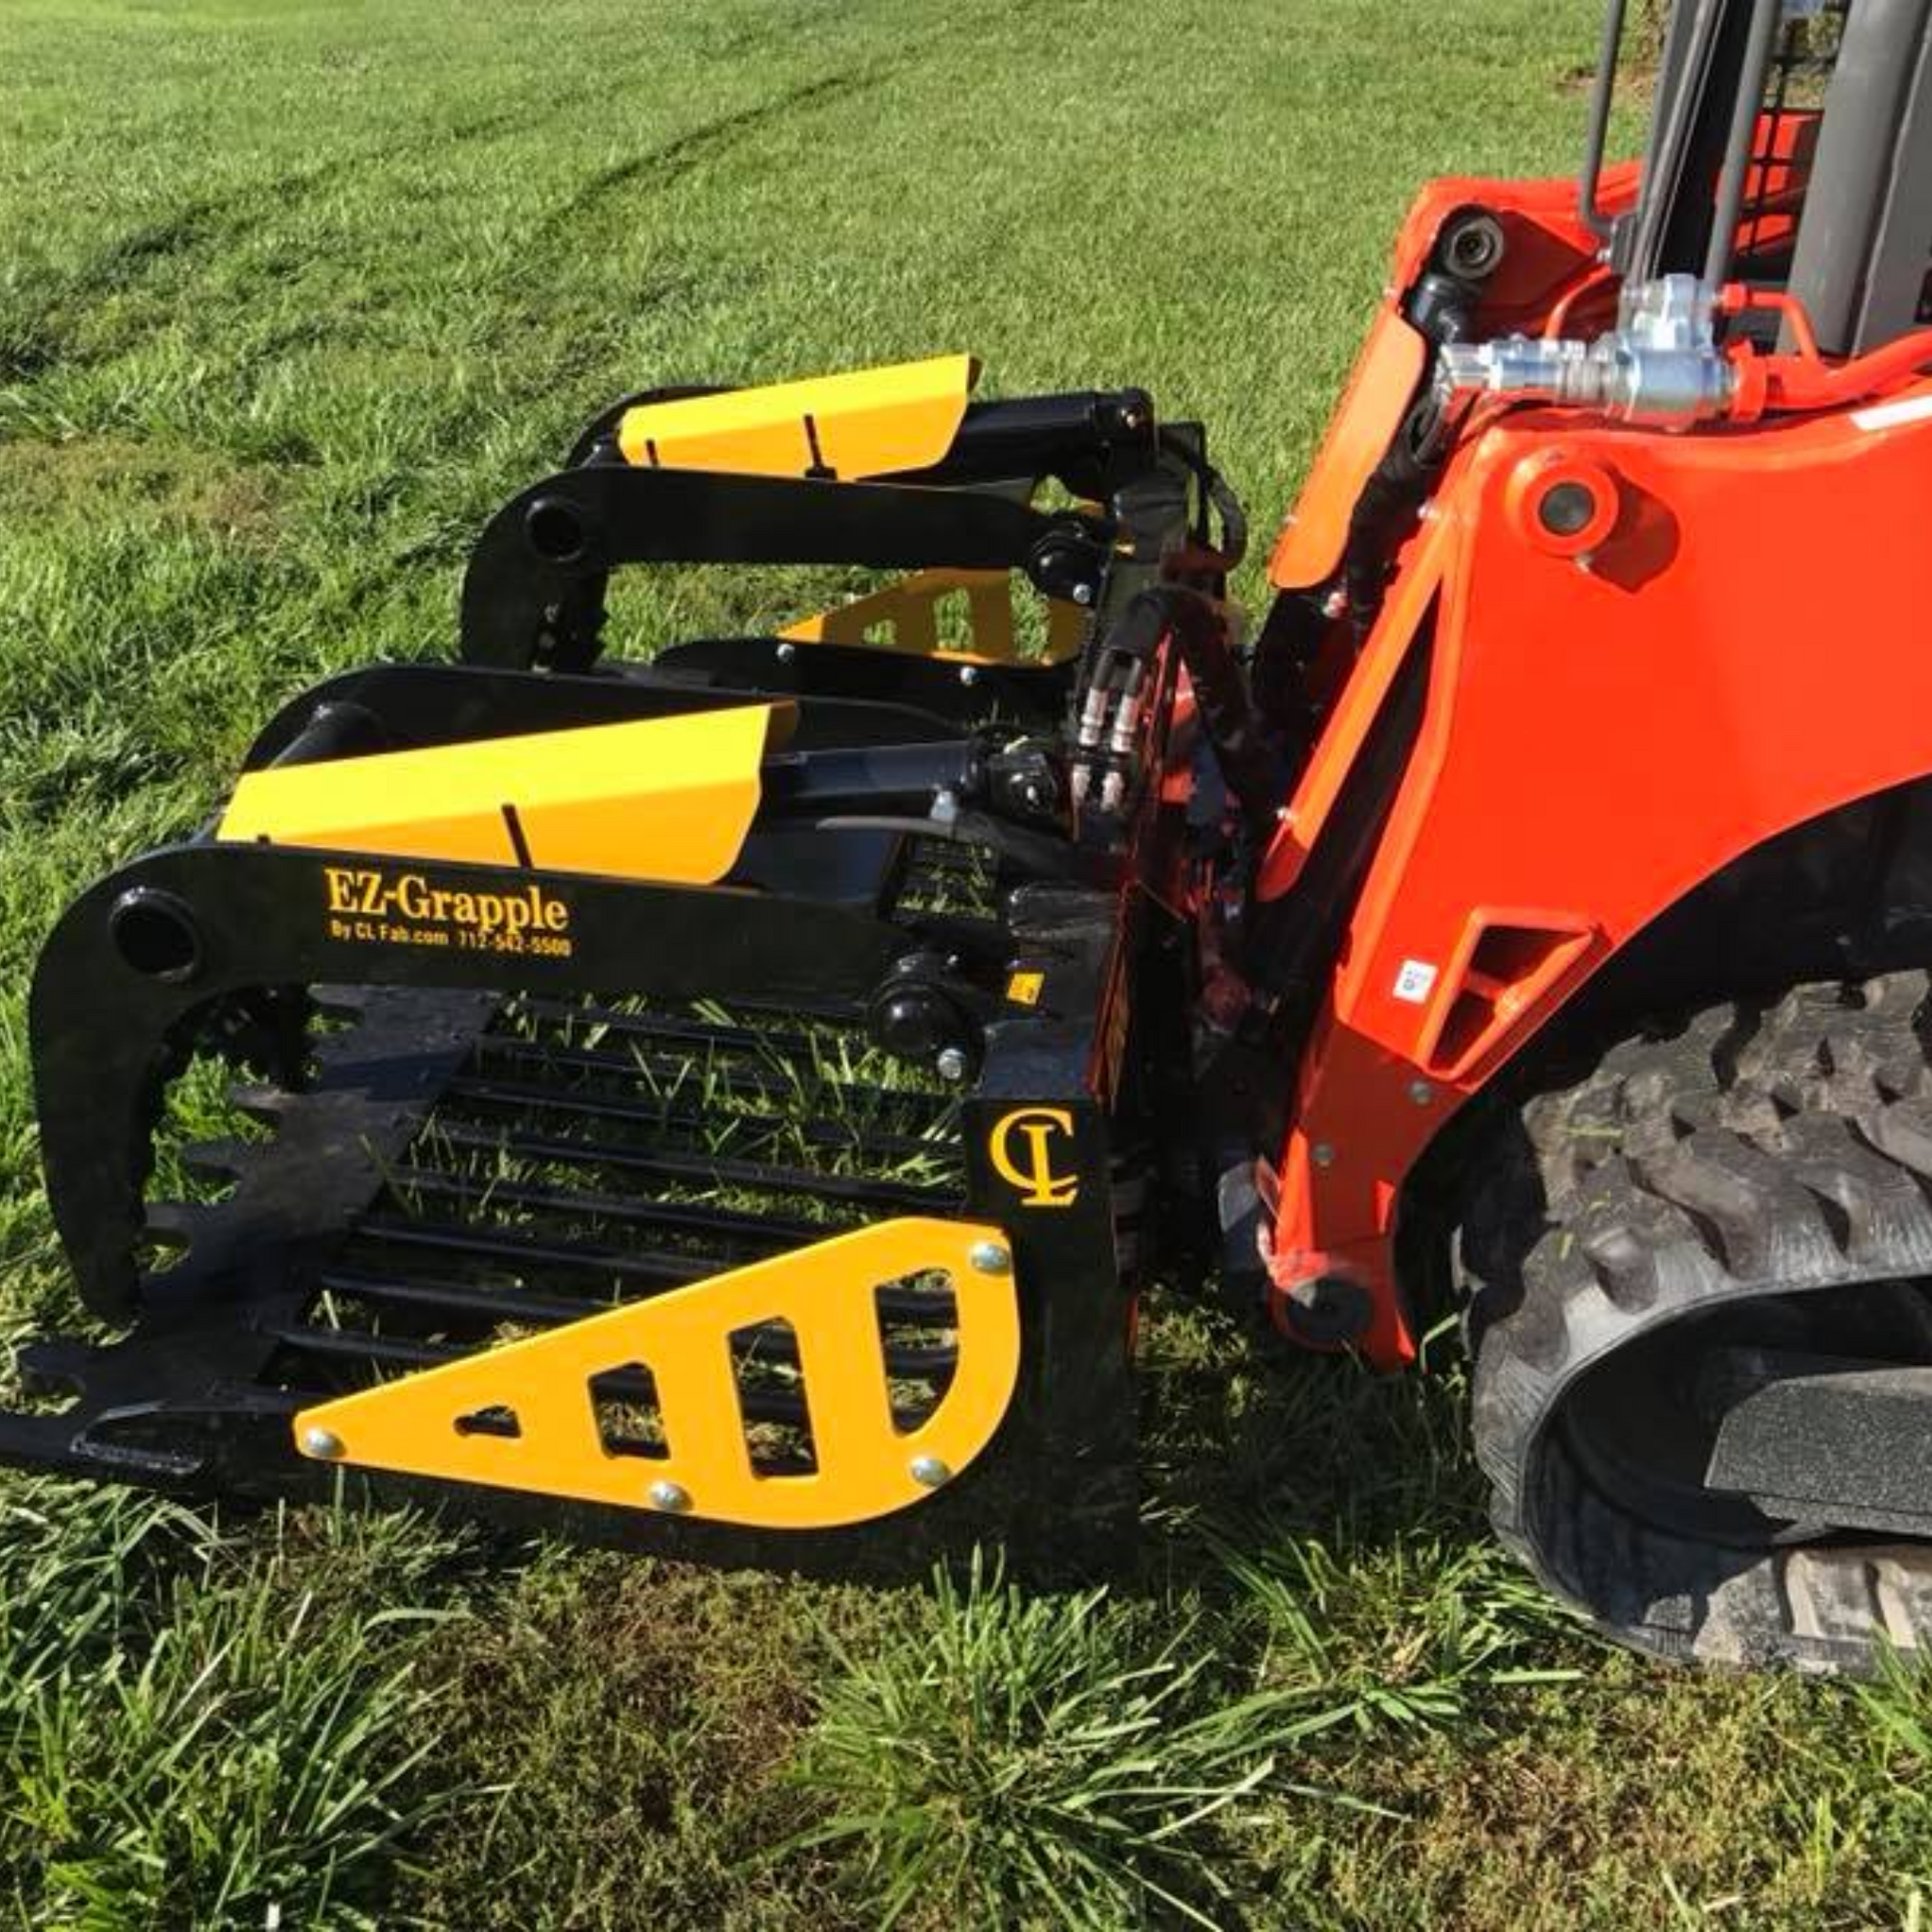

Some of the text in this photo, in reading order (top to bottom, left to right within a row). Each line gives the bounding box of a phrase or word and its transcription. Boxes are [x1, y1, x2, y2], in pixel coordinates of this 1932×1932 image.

[324, 869, 568, 934] EZ-Grapple
[331, 920, 351, 940] By
[354, 923, 376, 940] CL
